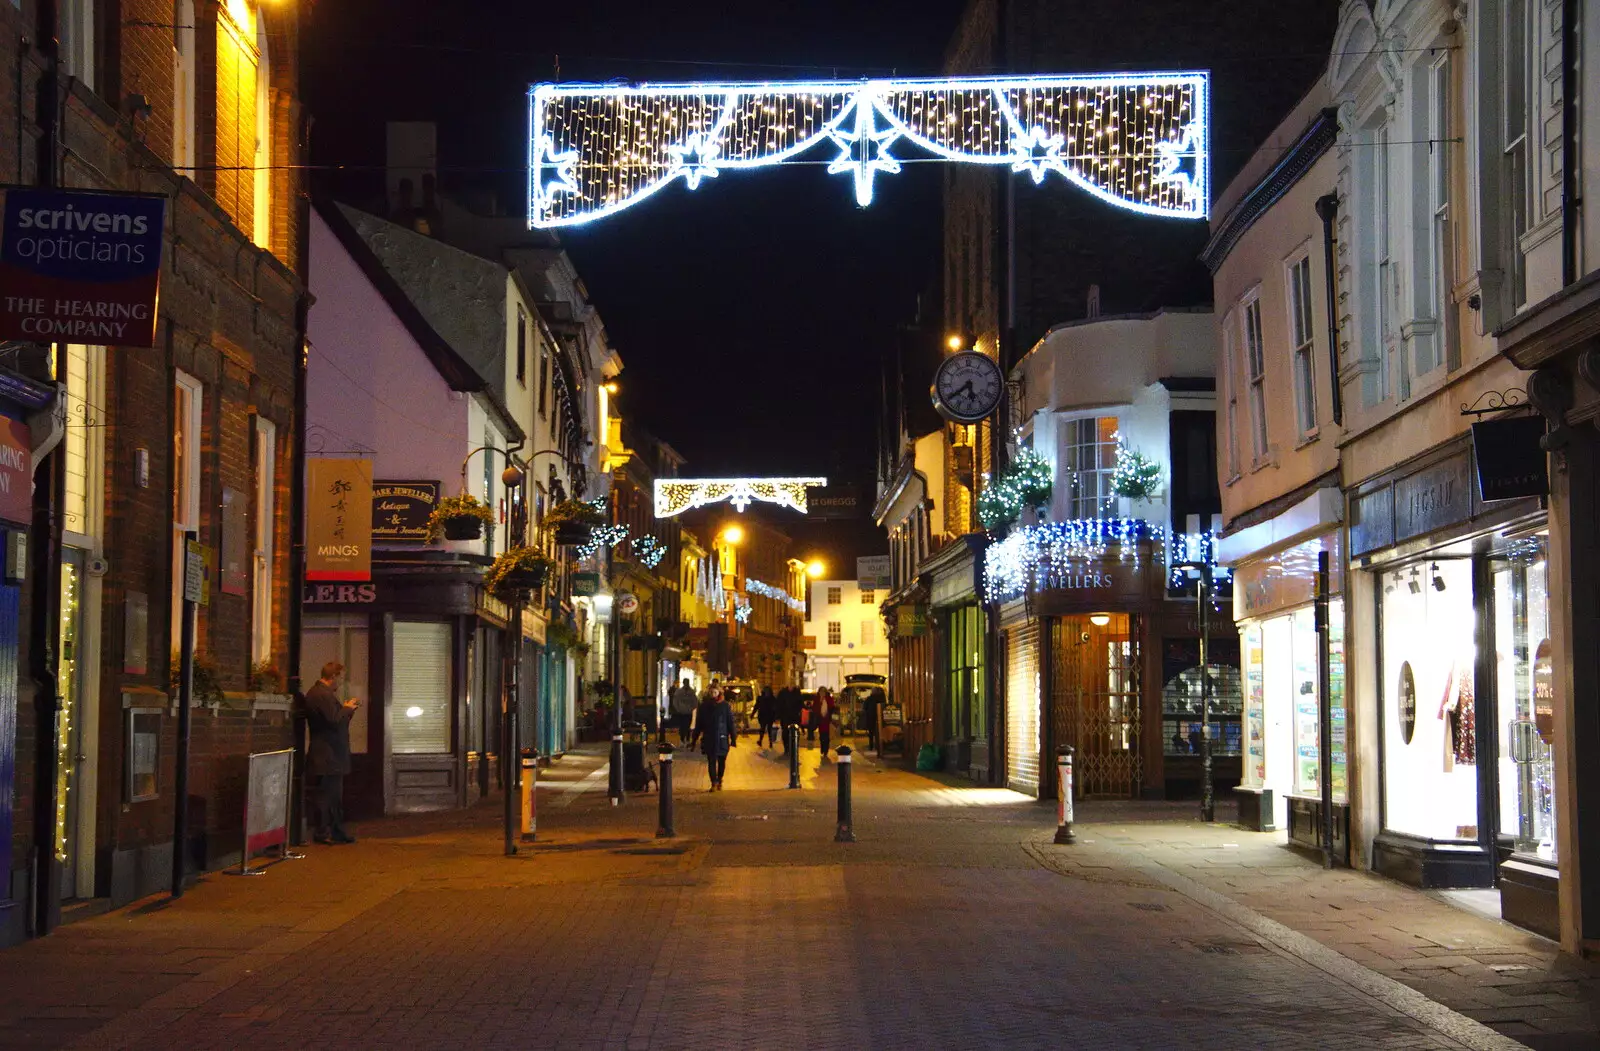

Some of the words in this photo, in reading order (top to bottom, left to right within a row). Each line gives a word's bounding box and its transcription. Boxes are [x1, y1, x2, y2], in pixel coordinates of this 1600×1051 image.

[18, 203, 148, 235] scrivens
[16, 233, 146, 265] opticians
[5, 296, 46, 315] THE
[54, 299, 149, 320] HEARING
[20, 316, 128, 338] COMPANY
[393, 486, 435, 505] JEWELLERS
[820, 497, 857, 507] GREGGS
[391, 514, 401, 525] &
[317, 545, 359, 557] MINGS
[1041, 574, 1113, 591] EWELLERS
